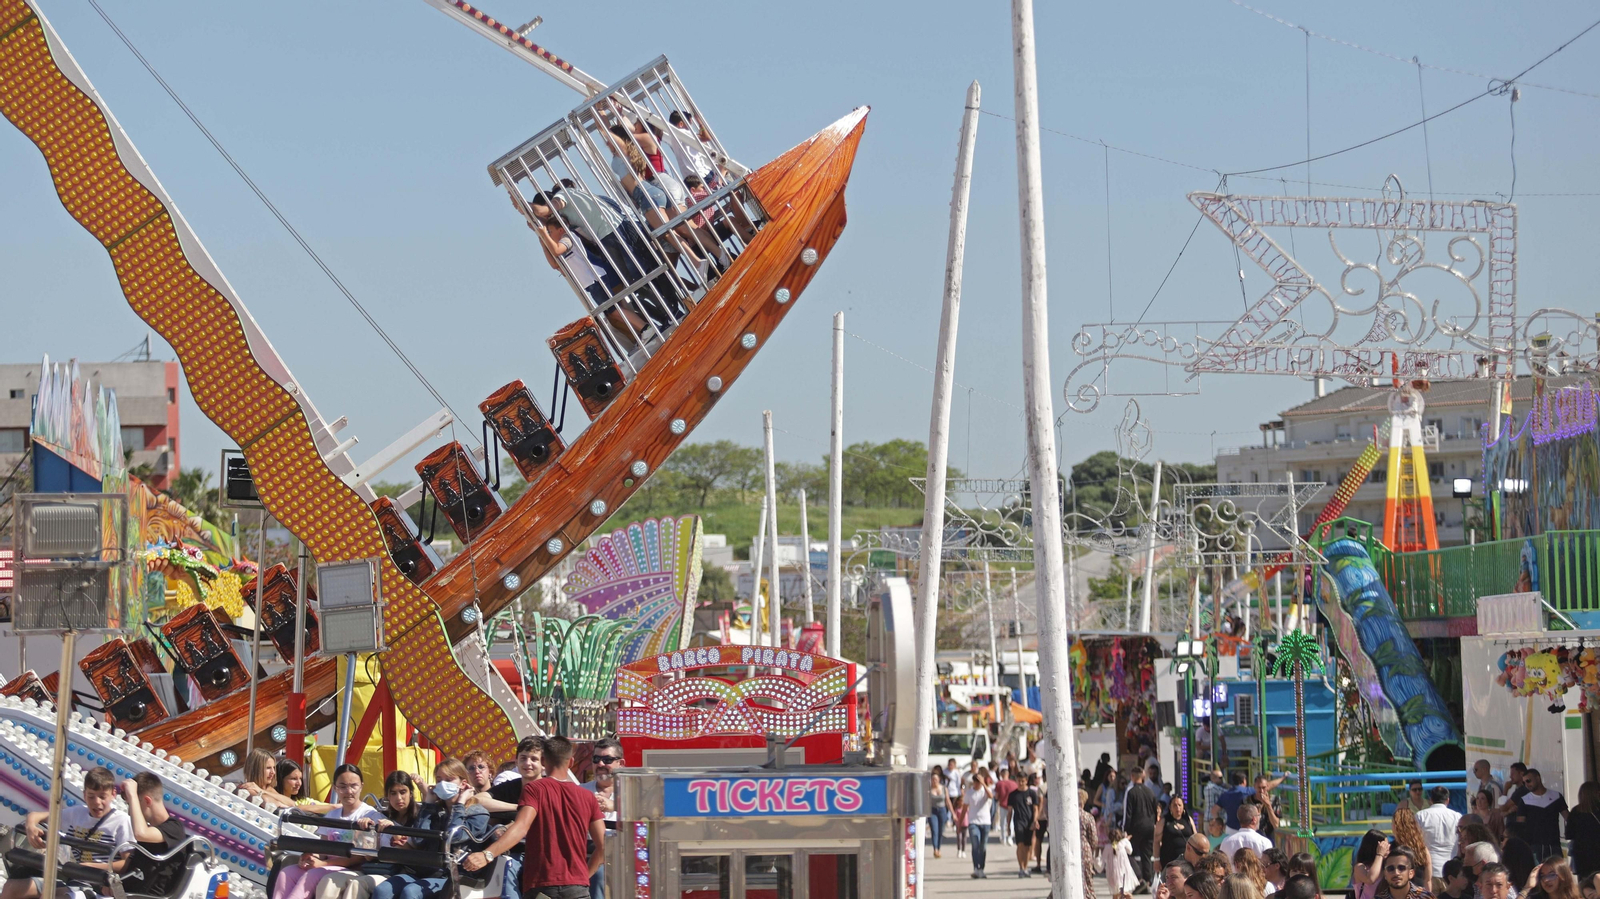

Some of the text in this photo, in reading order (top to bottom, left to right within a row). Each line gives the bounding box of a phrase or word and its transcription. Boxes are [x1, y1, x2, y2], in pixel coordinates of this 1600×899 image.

[657, 647, 814, 672] BARCO PIRATA
[687, 778, 863, 813] TICKETS
